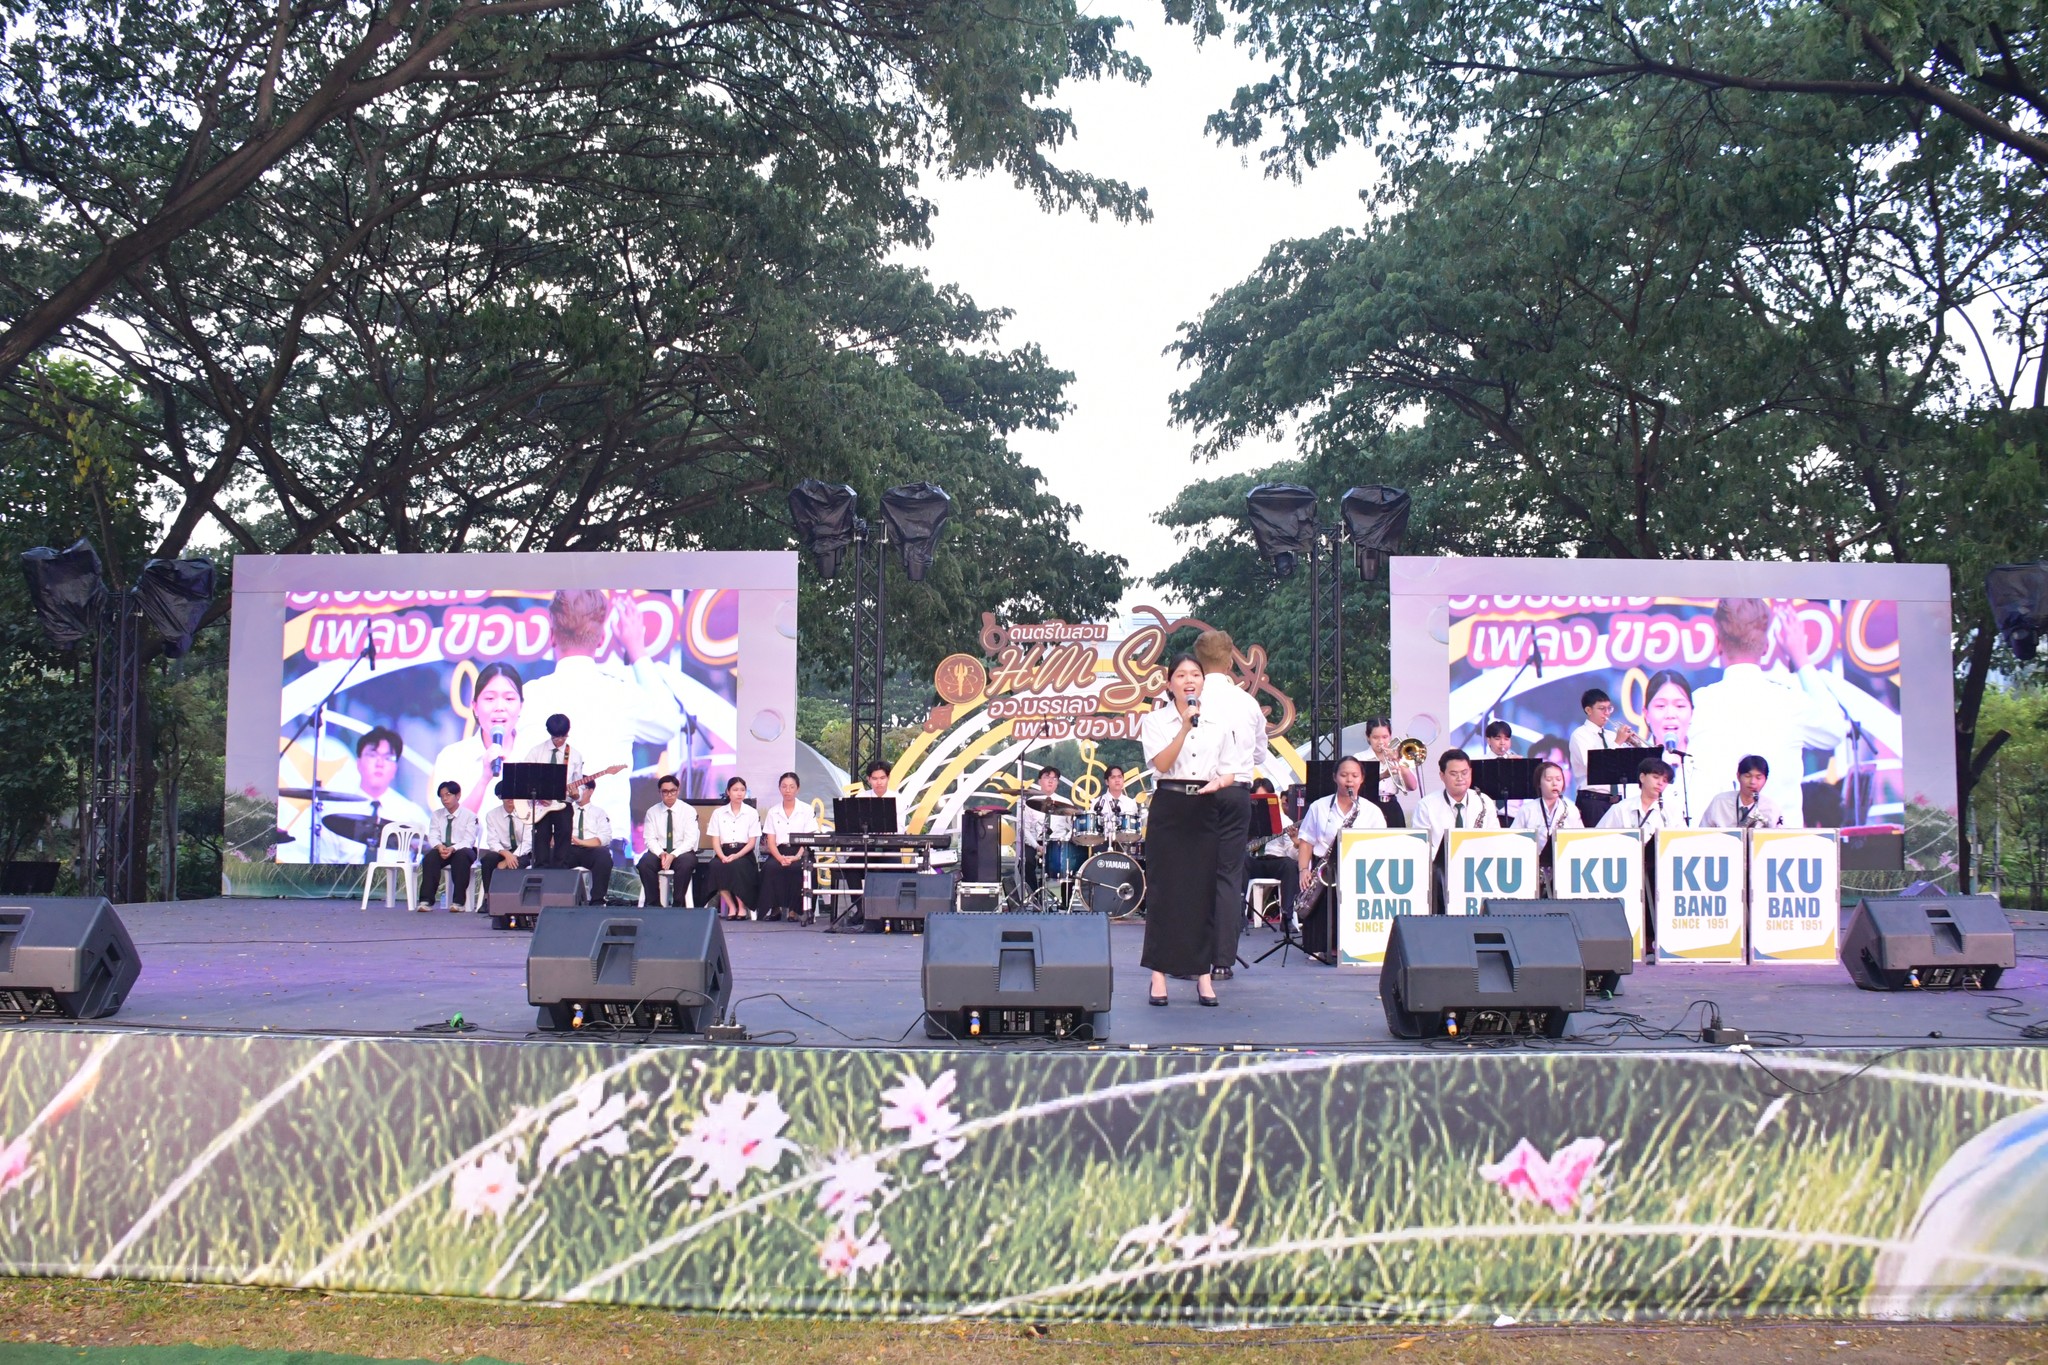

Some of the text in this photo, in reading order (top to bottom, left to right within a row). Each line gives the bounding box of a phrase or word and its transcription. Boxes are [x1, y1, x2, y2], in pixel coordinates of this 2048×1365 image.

[311, 617, 427, 654] เพลง
[1010, 623, 1106, 639] ดนตรีในสวน
[1473, 625, 1592, 662] เพลง
[990, 698, 1098, 715] อว.บรรเลง
[1105, 860, 1131, 869] YAMAHA
[1464, 857, 1522, 893] KU
[1571, 857, 1627, 893] KU
[1673, 856, 1729, 892] KU
[1355, 858, 1414, 895] KU
[1767, 858, 1822, 894] KU
[1357, 898, 1412, 920] BAND
[1674, 895, 1727, 917] BAND
[1768, 897, 1820, 918] BAND
[1355, 921, 1384, 933] SINCE
[1672, 918, 1729, 929] SINCE 1951
[1766, 919, 1823, 931] SINCE 1951
